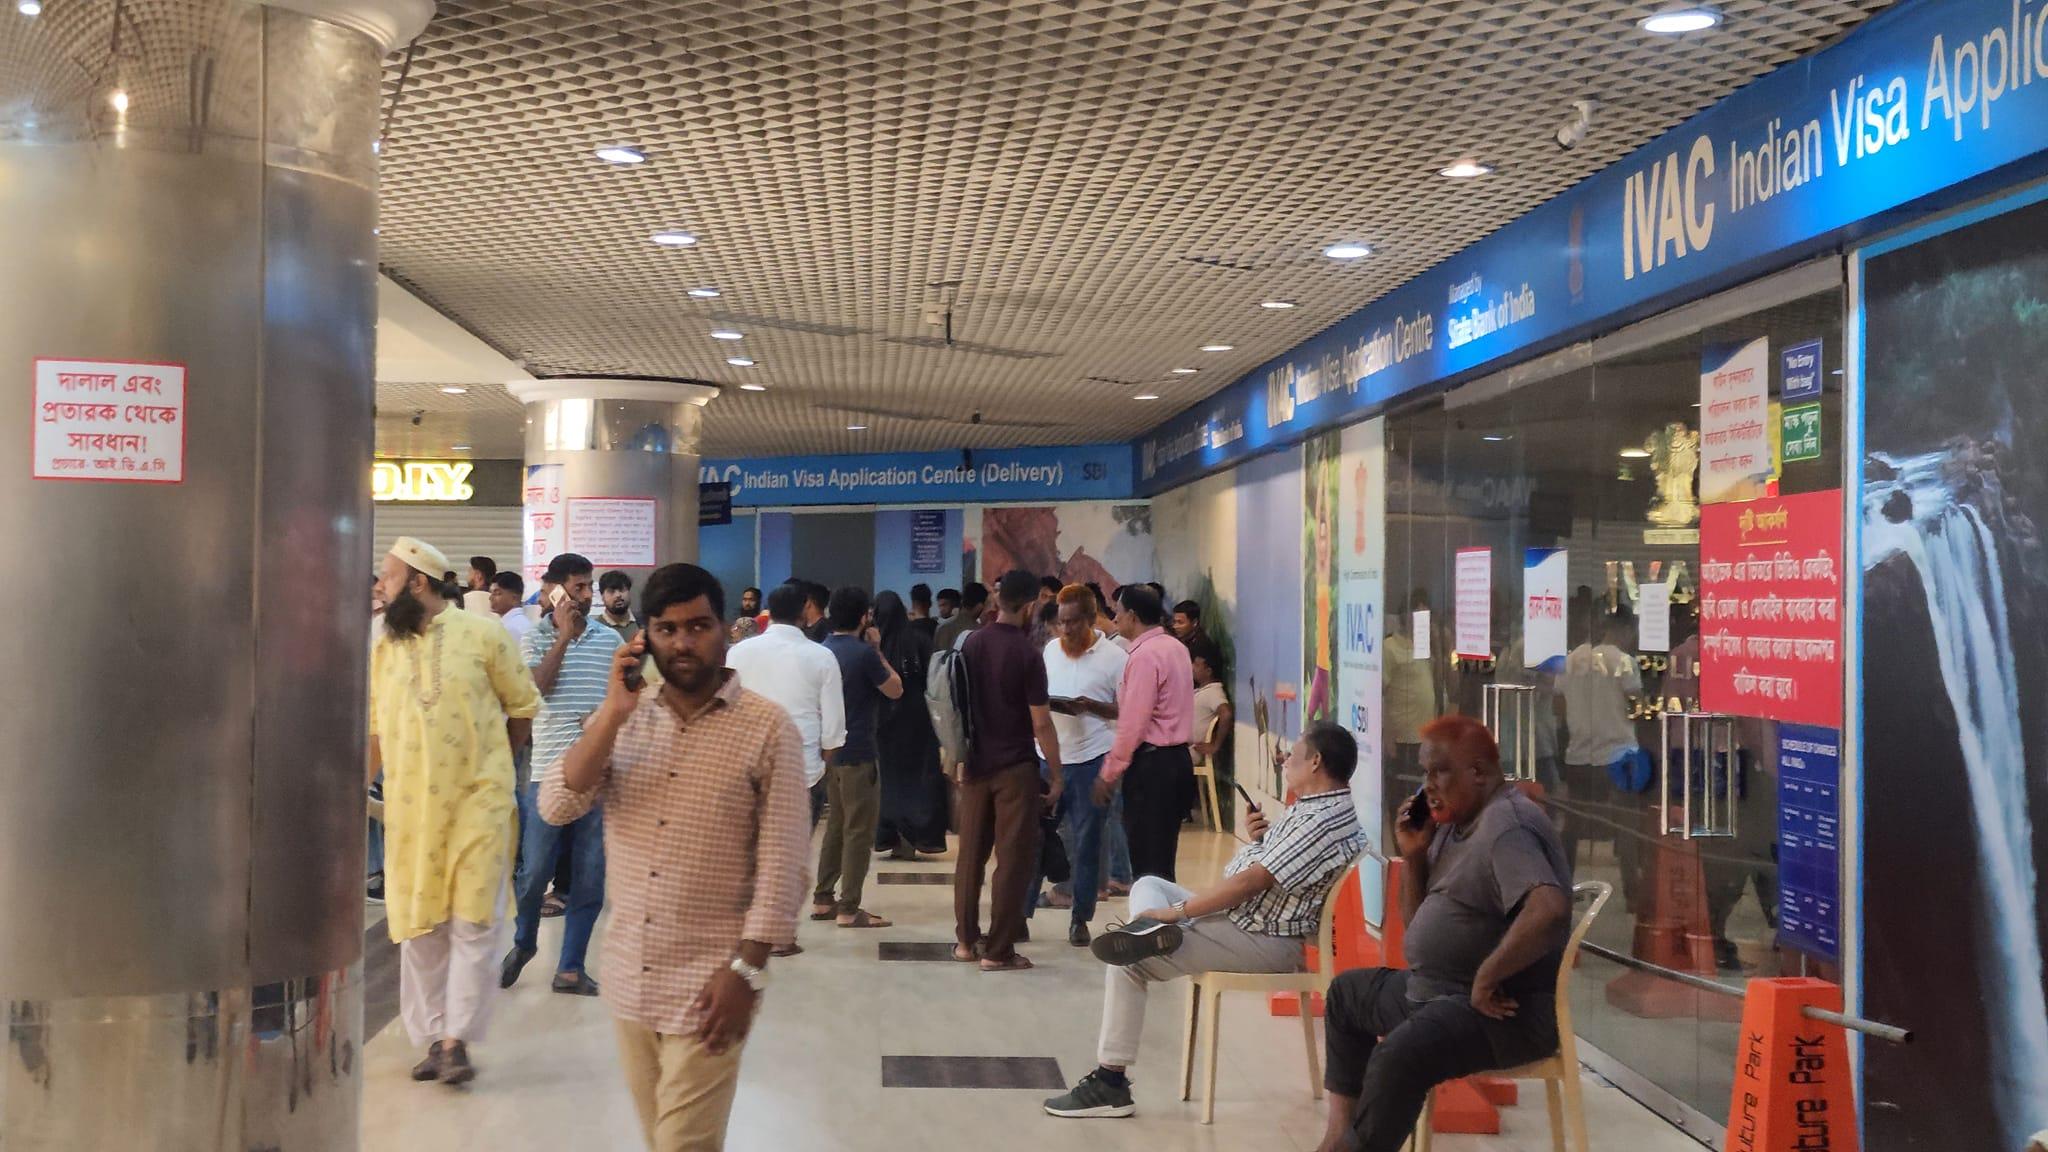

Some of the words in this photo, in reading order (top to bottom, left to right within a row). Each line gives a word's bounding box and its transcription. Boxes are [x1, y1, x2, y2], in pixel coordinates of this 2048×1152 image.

[1624, 135, 1715, 281] IVAC
[1731, 118, 1822, 213] Indian
[1829, 75, 1910, 167] Visa
[1471, 299, 1497, 340] Bank
[1498, 290, 1509, 329] of
[1509, 282, 1535, 324] India
[1394, 310, 1434, 363] Centre
[57, 372, 117, 393] দালাল
[123, 375, 162, 395] এবং
[43, 402, 118, 424] প্রতারক
[125, 405, 178, 424] থেকে
[67, 433, 148, 453] সাবধান!
[744, 471, 789, 489] Indian
[793, 469, 824, 488] Visa
[828, 467, 917, 491] Application
[921, 463, 977, 485] Centre
[981, 460, 1064, 487] (Delivery)
[1744, 1032, 1764, 1081] Park
[1789, 1034, 1826, 1084] Park
